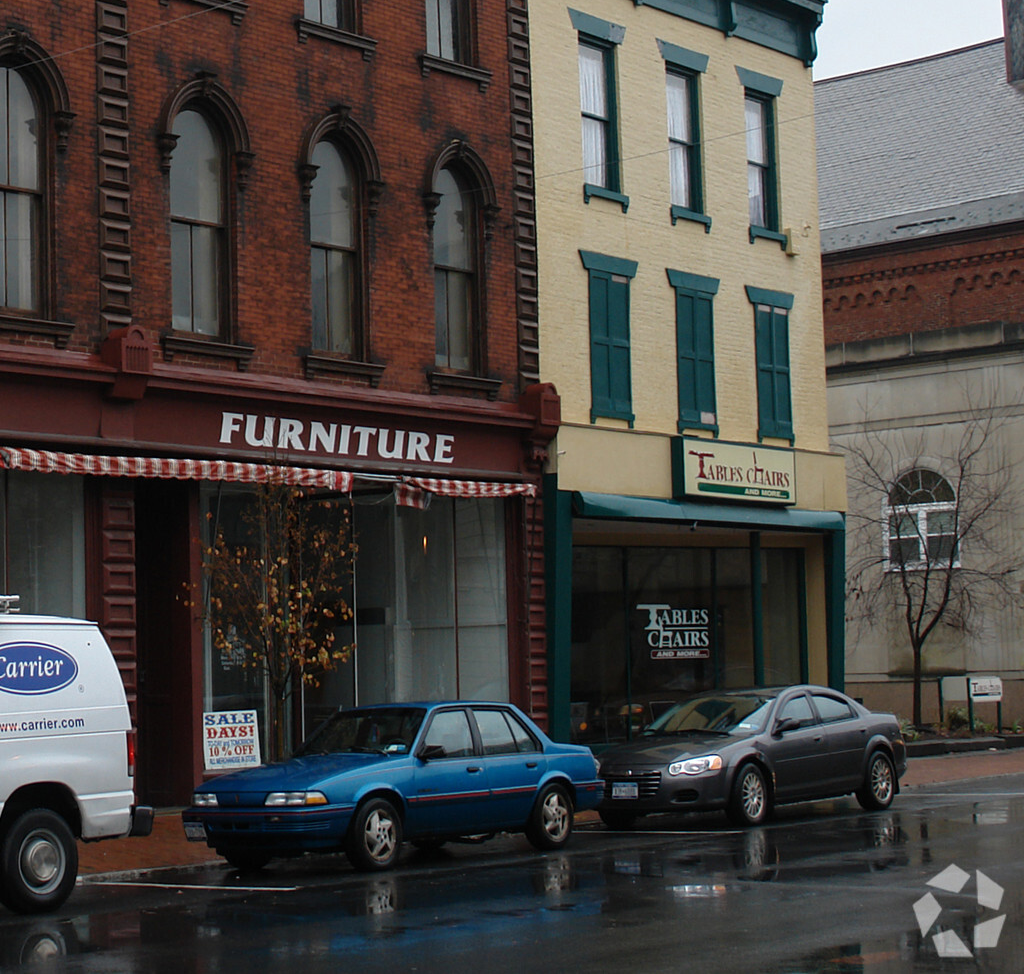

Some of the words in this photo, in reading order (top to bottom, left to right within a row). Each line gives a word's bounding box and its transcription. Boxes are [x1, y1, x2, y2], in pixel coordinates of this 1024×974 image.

[219, 412, 455, 463] FURNITURE
[688, 450, 743, 483] TABLES
[744, 487, 760, 496] AND
[636, 604, 709, 630] TABLES
[647, 616, 710, 648] CHAIRS
[656, 650, 674, 658] AND
[204, 712, 255, 726] SALE
[206, 725, 255, 739] DAYS!
[209, 747, 220, 757] 10
[234, 744, 255, 756] OFF
